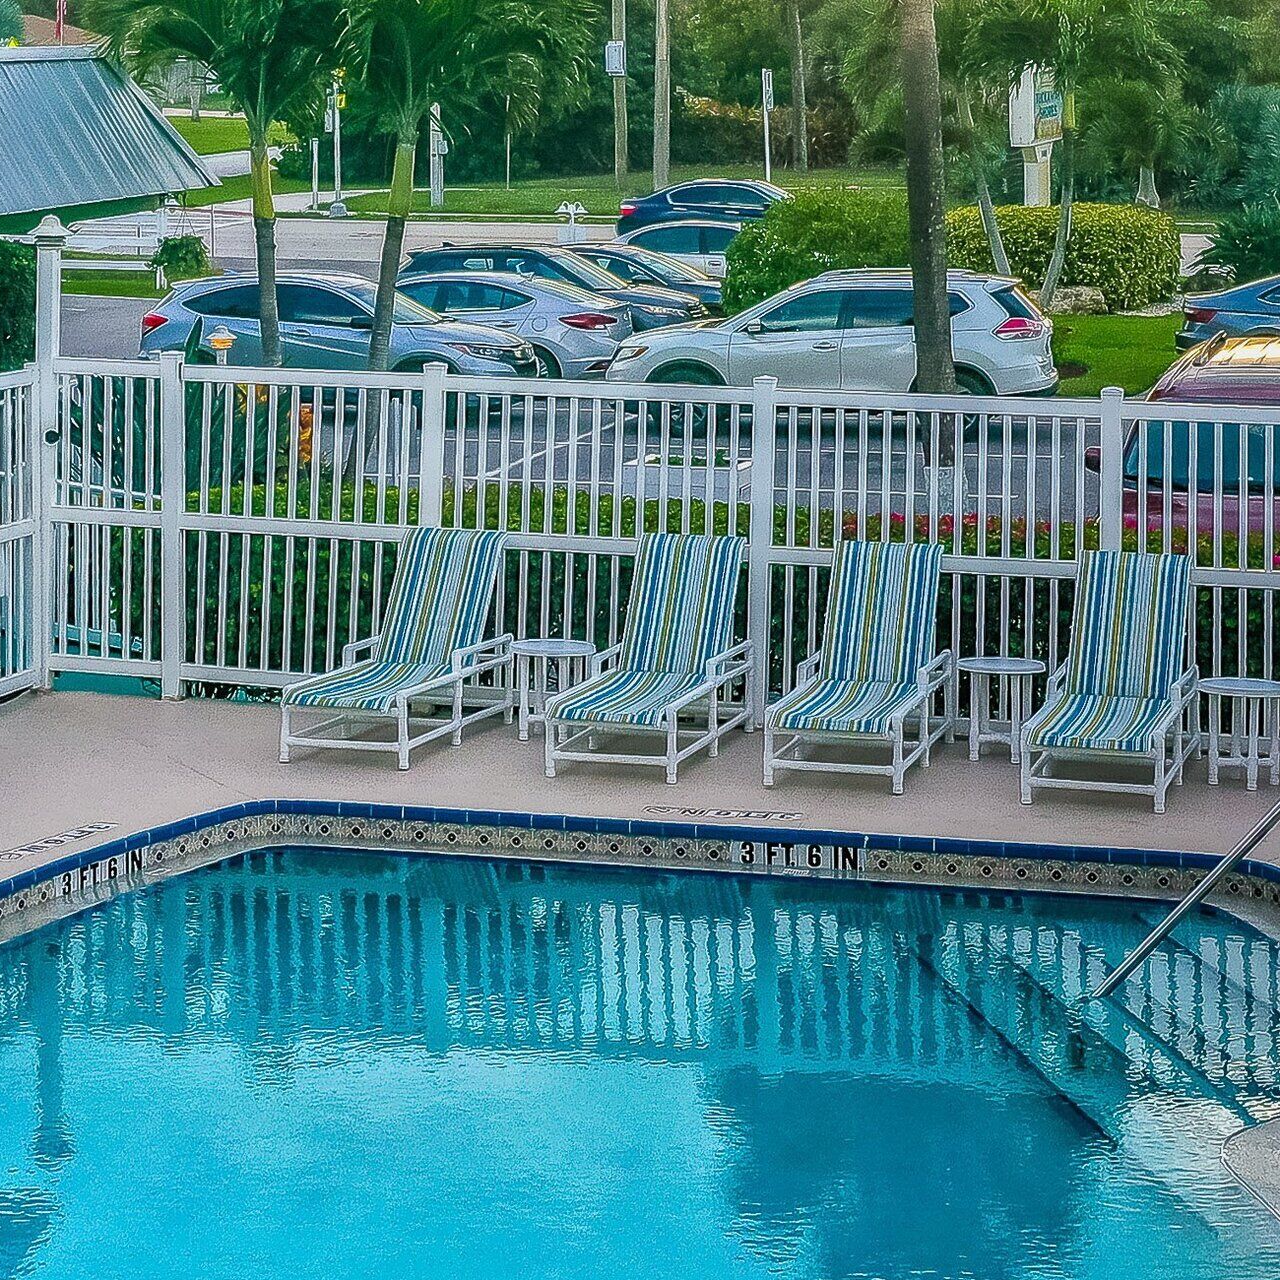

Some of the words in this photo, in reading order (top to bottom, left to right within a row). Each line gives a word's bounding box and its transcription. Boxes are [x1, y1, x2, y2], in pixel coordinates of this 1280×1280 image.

[741, 841, 755, 864] 3
[767, 843, 795, 867] FT.
[807, 845, 821, 867] 6
[834, 846, 862, 871] IN.
[62, 873, 72, 895] 3
[108, 857, 117, 879] 6
